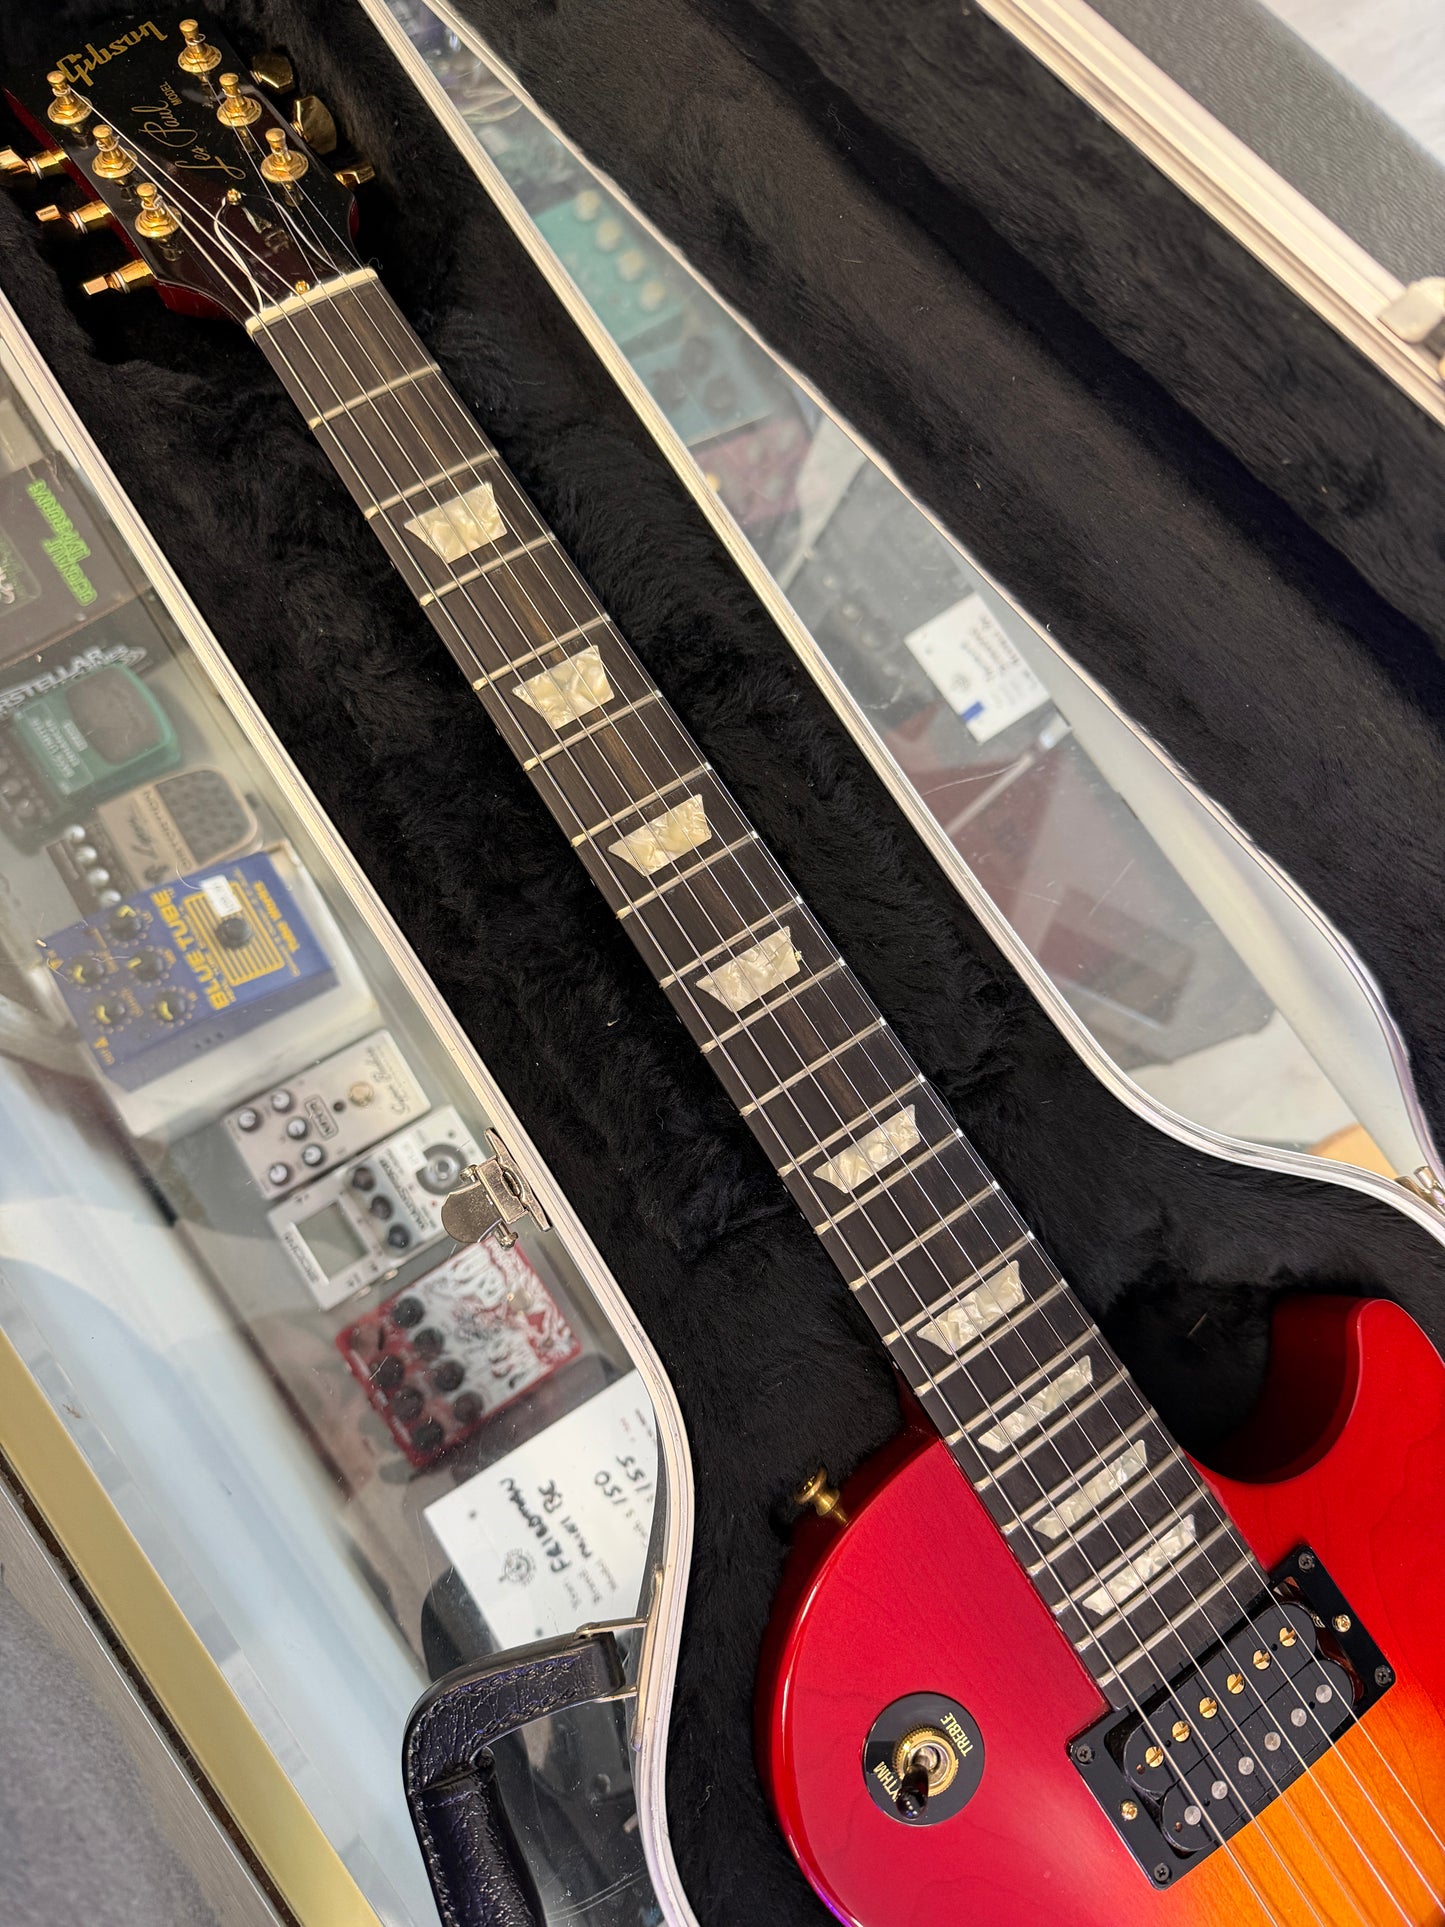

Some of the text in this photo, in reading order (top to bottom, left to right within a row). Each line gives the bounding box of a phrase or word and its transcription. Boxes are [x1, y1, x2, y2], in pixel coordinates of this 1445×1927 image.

[56, 21, 168, 87] Gibson
[160, 81, 183, 106] MODEL
[131, 101, 246, 180] Les Paul
[150, 888, 195, 951] TUBE
[184, 948, 230, 1011] BLUE
[591, 1468, 628, 1509] 150
[615, 1450, 653, 1494] 155
[940, 1712, 974, 1757] TREBLE
[872, 1761, 902, 1802] YTHM
